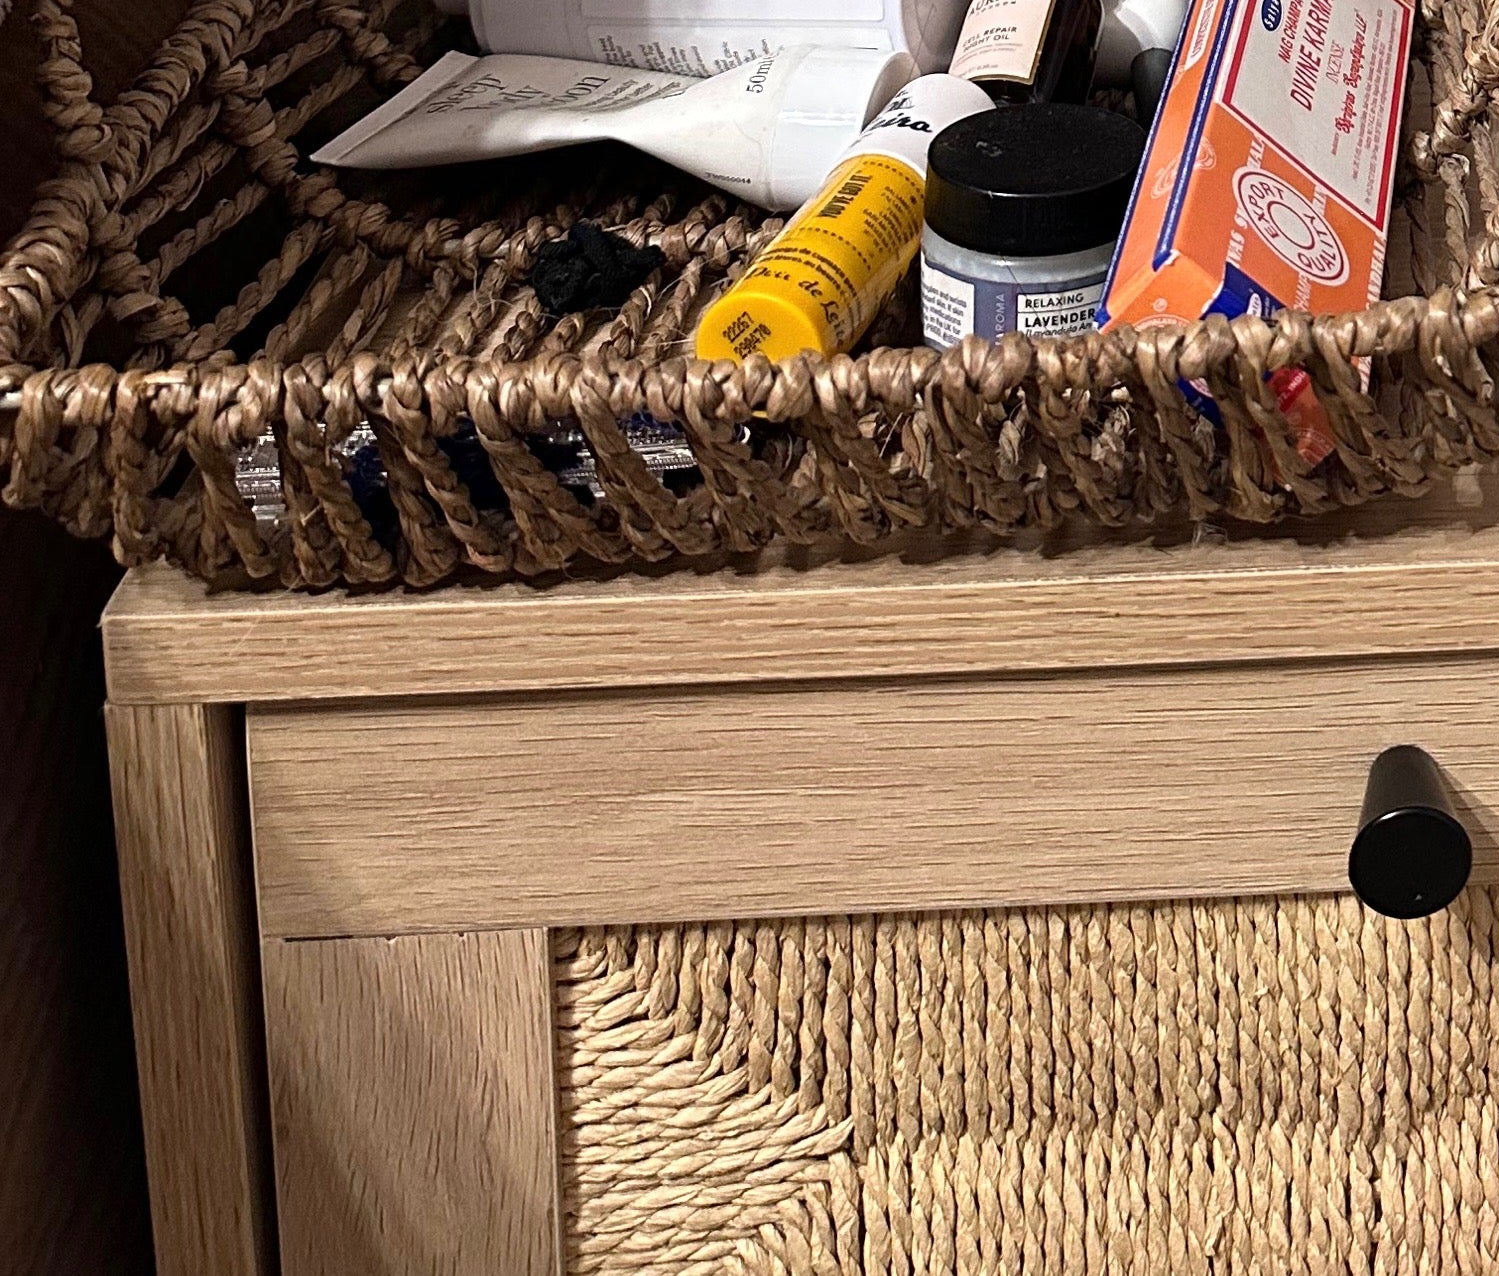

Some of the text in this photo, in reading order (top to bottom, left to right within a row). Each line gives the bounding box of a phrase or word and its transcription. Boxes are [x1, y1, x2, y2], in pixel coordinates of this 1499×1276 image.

[983, 26, 1017, 36] REPAIR
[1278, 35, 1295, 63] NAG
[1290, 46, 1322, 112] DIVINE
[1248, 181, 1284, 239] EXPORT
[1297, 213, 1336, 271] QUALITY
[798, 279, 823, 298] de
[1025, 293, 1084, 309] RELAXING
[1025, 308, 1096, 328] LAVENDER
